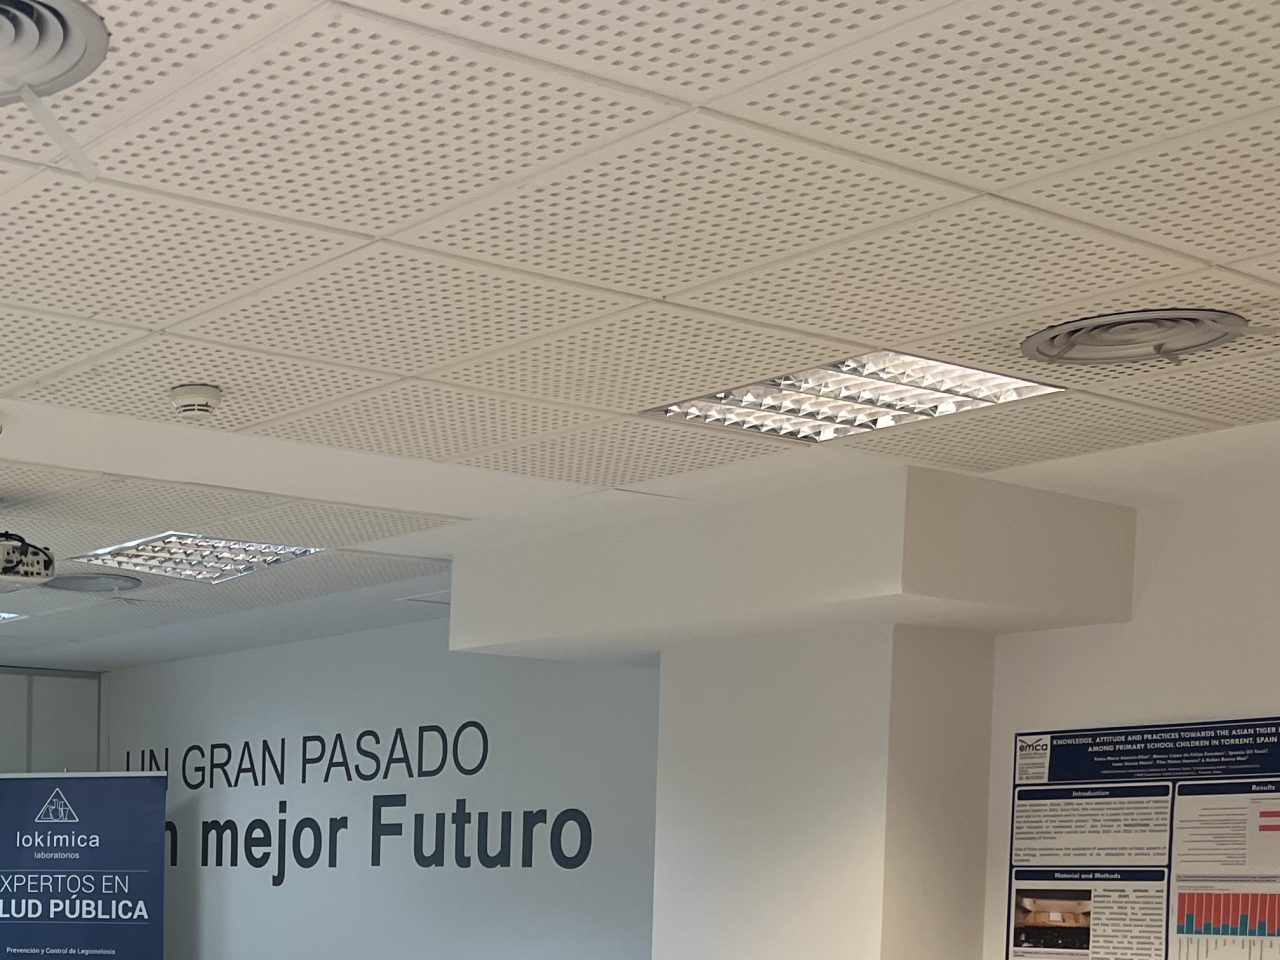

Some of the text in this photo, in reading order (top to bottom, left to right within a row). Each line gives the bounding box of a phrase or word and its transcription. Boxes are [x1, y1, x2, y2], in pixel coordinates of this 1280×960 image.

[1052, 726, 1276, 746] KNOWLEDGE, ATTITUDE AND PRACTICES TOWARDS THE ASIAN TIGER
[1088, 735, 1278, 753] AMONG PRIMARY SCHOOL CHILDREN IN TORRENT, SPAIN
[182, 738, 286, 790] GRAN
[301, 720, 489, 784] PASADO
[1018, 742, 1049, 752] emca
[1072, 789, 1110, 798] Introduction
[1251, 783, 1276, 792] Results
[16, 830, 100, 848] lokímica
[201, 800, 348, 887] mejor
[370, 793, 593, 870] Futuro
[34, 851, 80, 859] laboratorios
[102, 875, 129, 893] EN
[1054, 872, 1121, 880] Material and Methods
[49, 894, 149, 920] PÚBLICA
[6, 946, 40, 954] Prevención
[45, 947, 68, 955] Control
